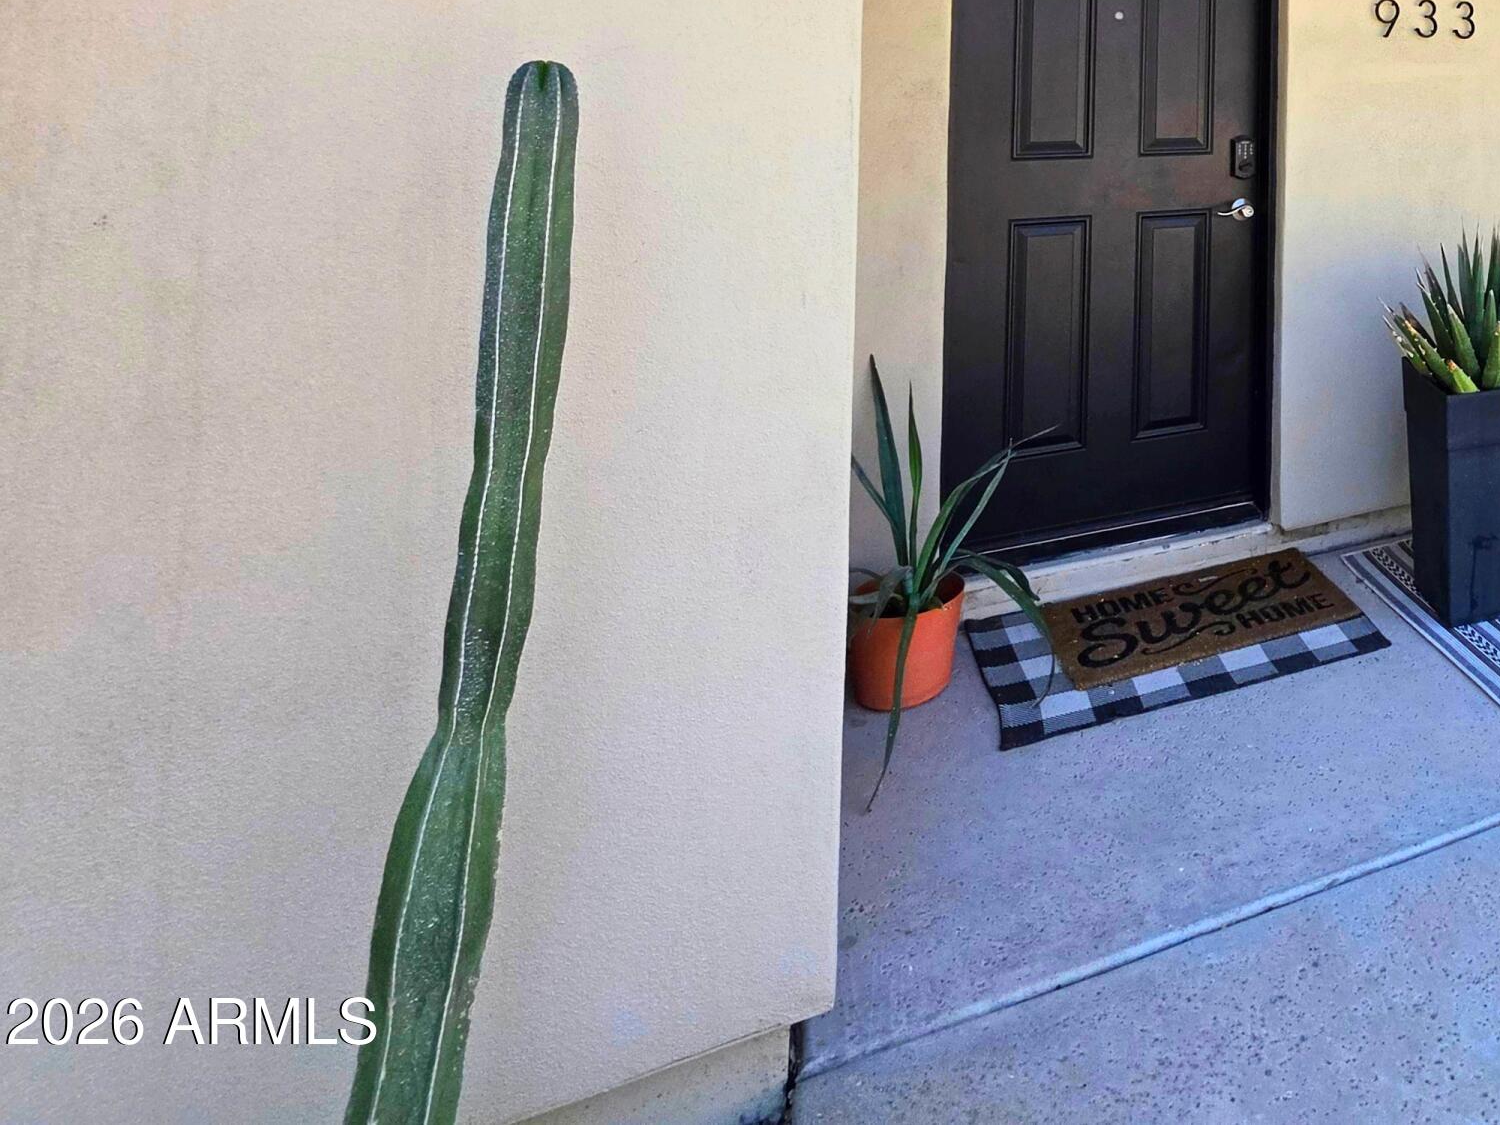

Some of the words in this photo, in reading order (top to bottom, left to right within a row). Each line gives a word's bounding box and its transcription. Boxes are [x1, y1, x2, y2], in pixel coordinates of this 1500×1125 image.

[1071, 586, 1173, 625] HOME
[1077, 560, 1311, 669] Sweet
[1240, 593, 1335, 630] HOME
